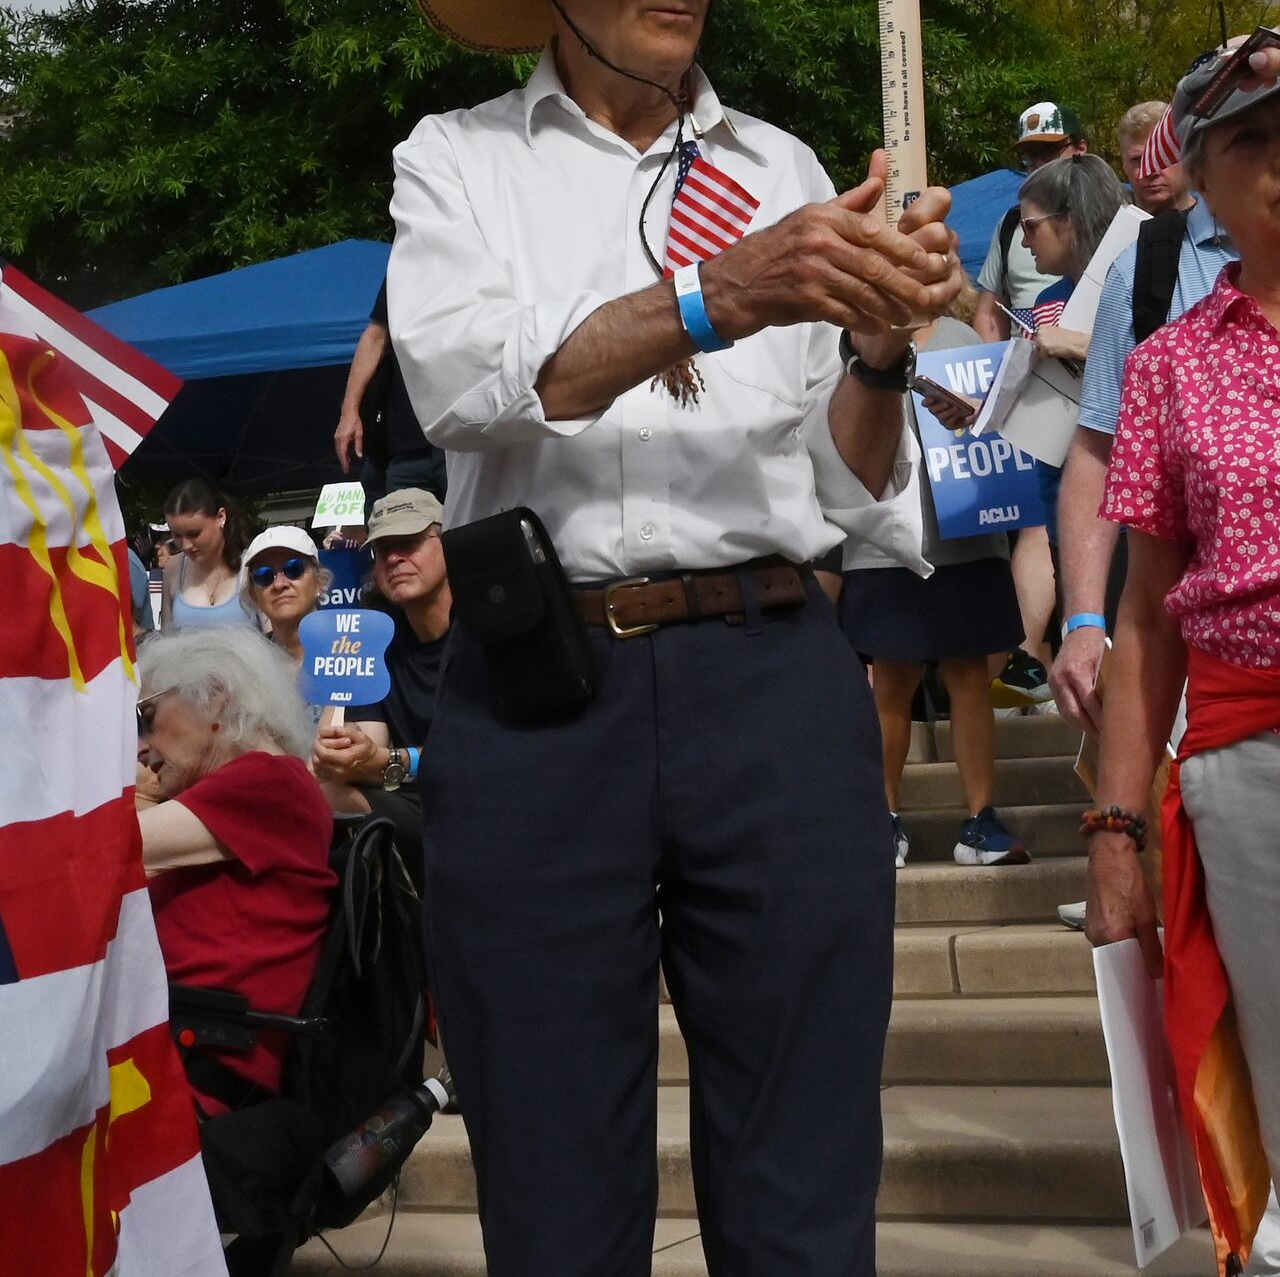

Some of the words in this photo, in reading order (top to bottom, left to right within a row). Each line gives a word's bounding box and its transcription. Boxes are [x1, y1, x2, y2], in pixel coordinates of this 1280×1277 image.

[903, 129, 909, 141] Do
[928, 439, 1037, 483] PEOPL
[979, 505, 1020, 525] ACLU
[336, 614, 360, 633] WE
[331, 635, 362, 654] the
[314, 656, 375, 676] PEOPLE
[330, 692, 352, 701] ACLU
